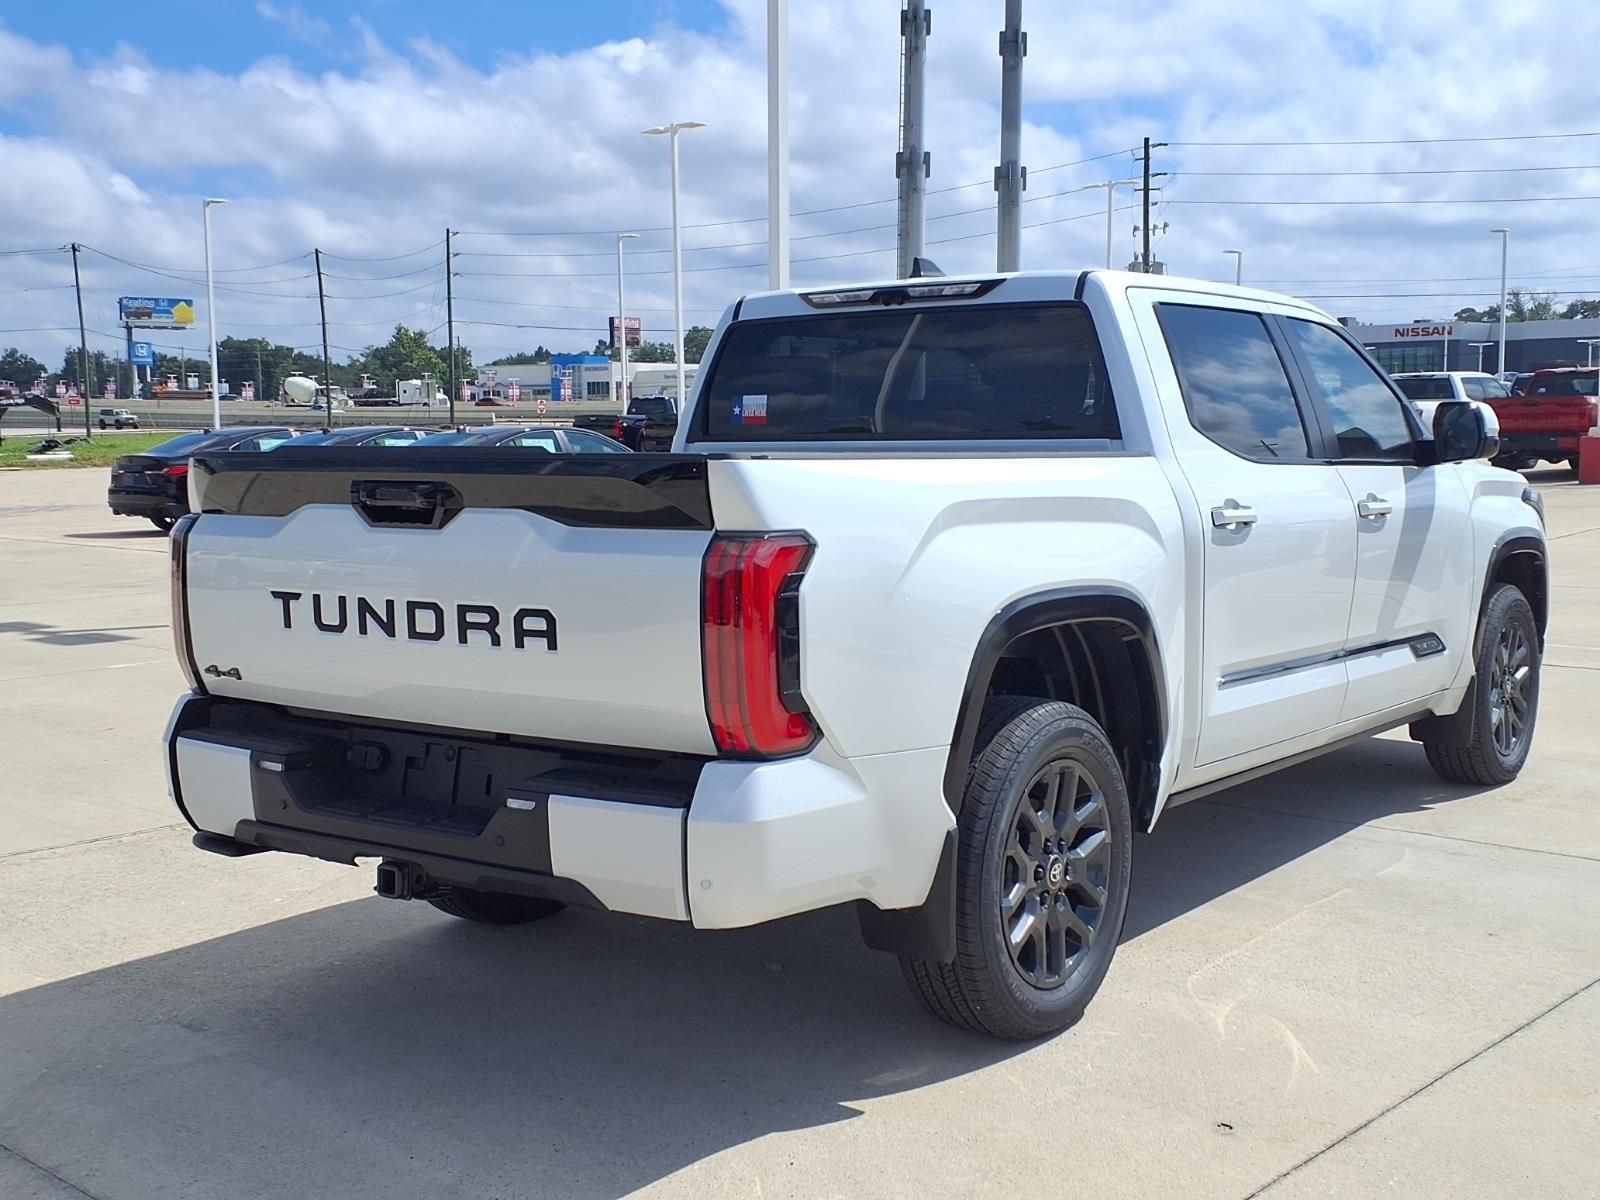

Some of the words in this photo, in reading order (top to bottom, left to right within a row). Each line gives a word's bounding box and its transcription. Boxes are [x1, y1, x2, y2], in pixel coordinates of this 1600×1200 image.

[122, 298, 155, 308] Keating
[1394, 326, 1453, 338] NISSAN
[270, 590, 558, 651] TUNDRA
